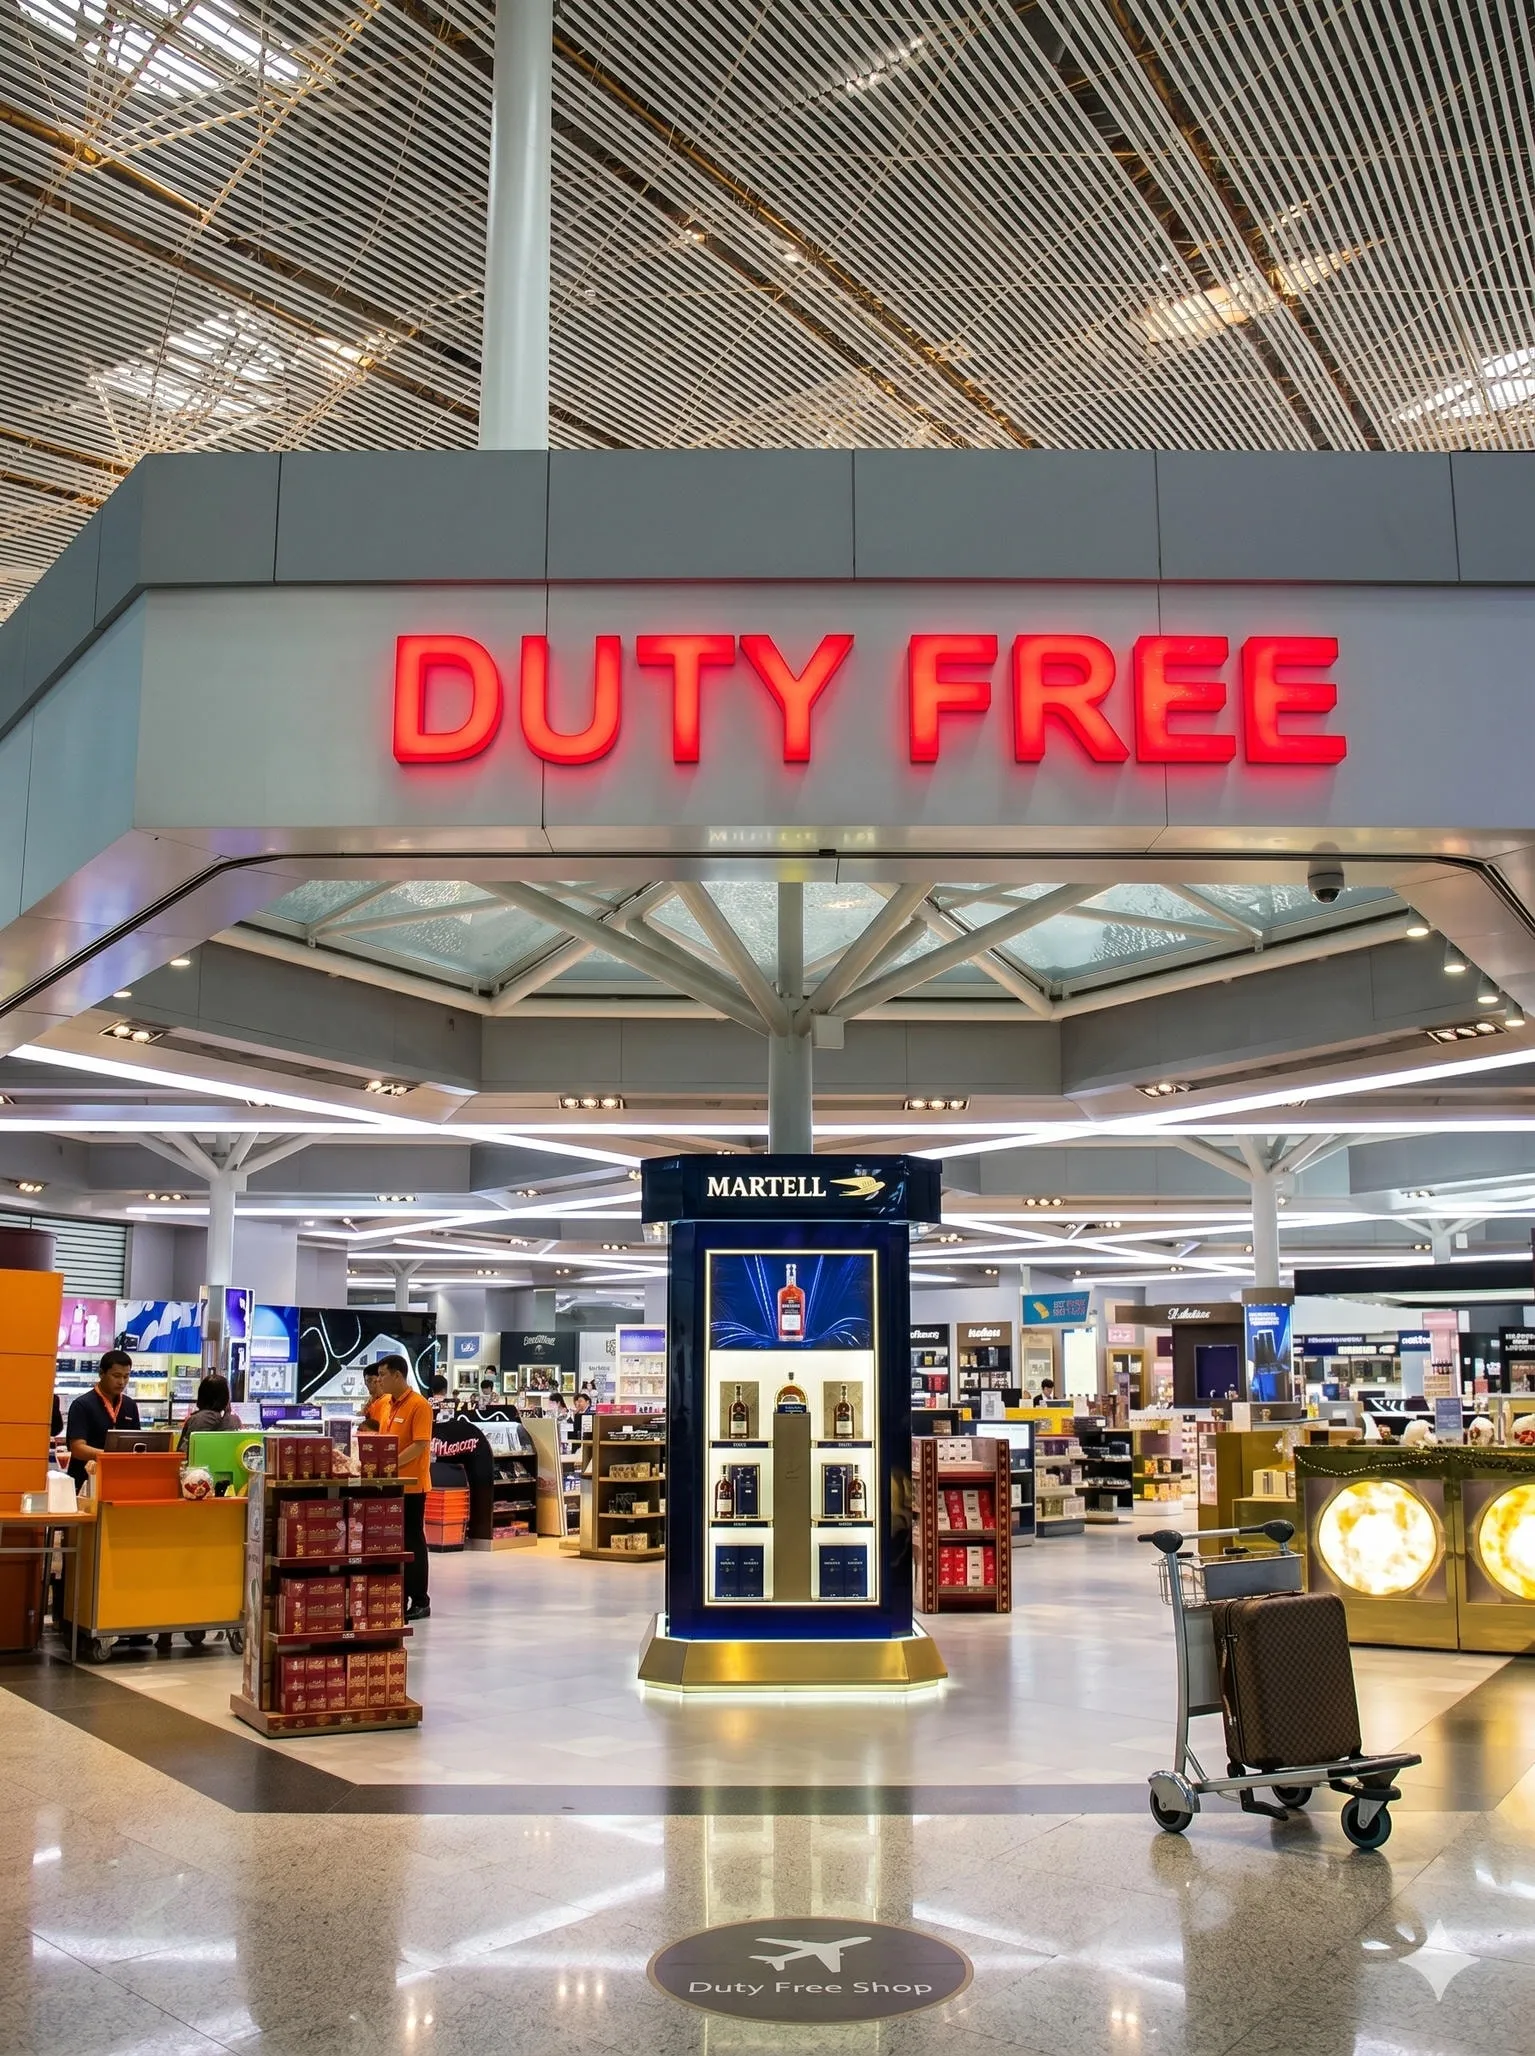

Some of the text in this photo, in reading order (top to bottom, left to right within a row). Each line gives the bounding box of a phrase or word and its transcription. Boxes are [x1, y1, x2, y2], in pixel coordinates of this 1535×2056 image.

[393, 634, 1347, 765] DUTY FREE
[706, 1176, 827, 1198] MARTELL
[688, 1981, 932, 1996] Duty Free Shop
